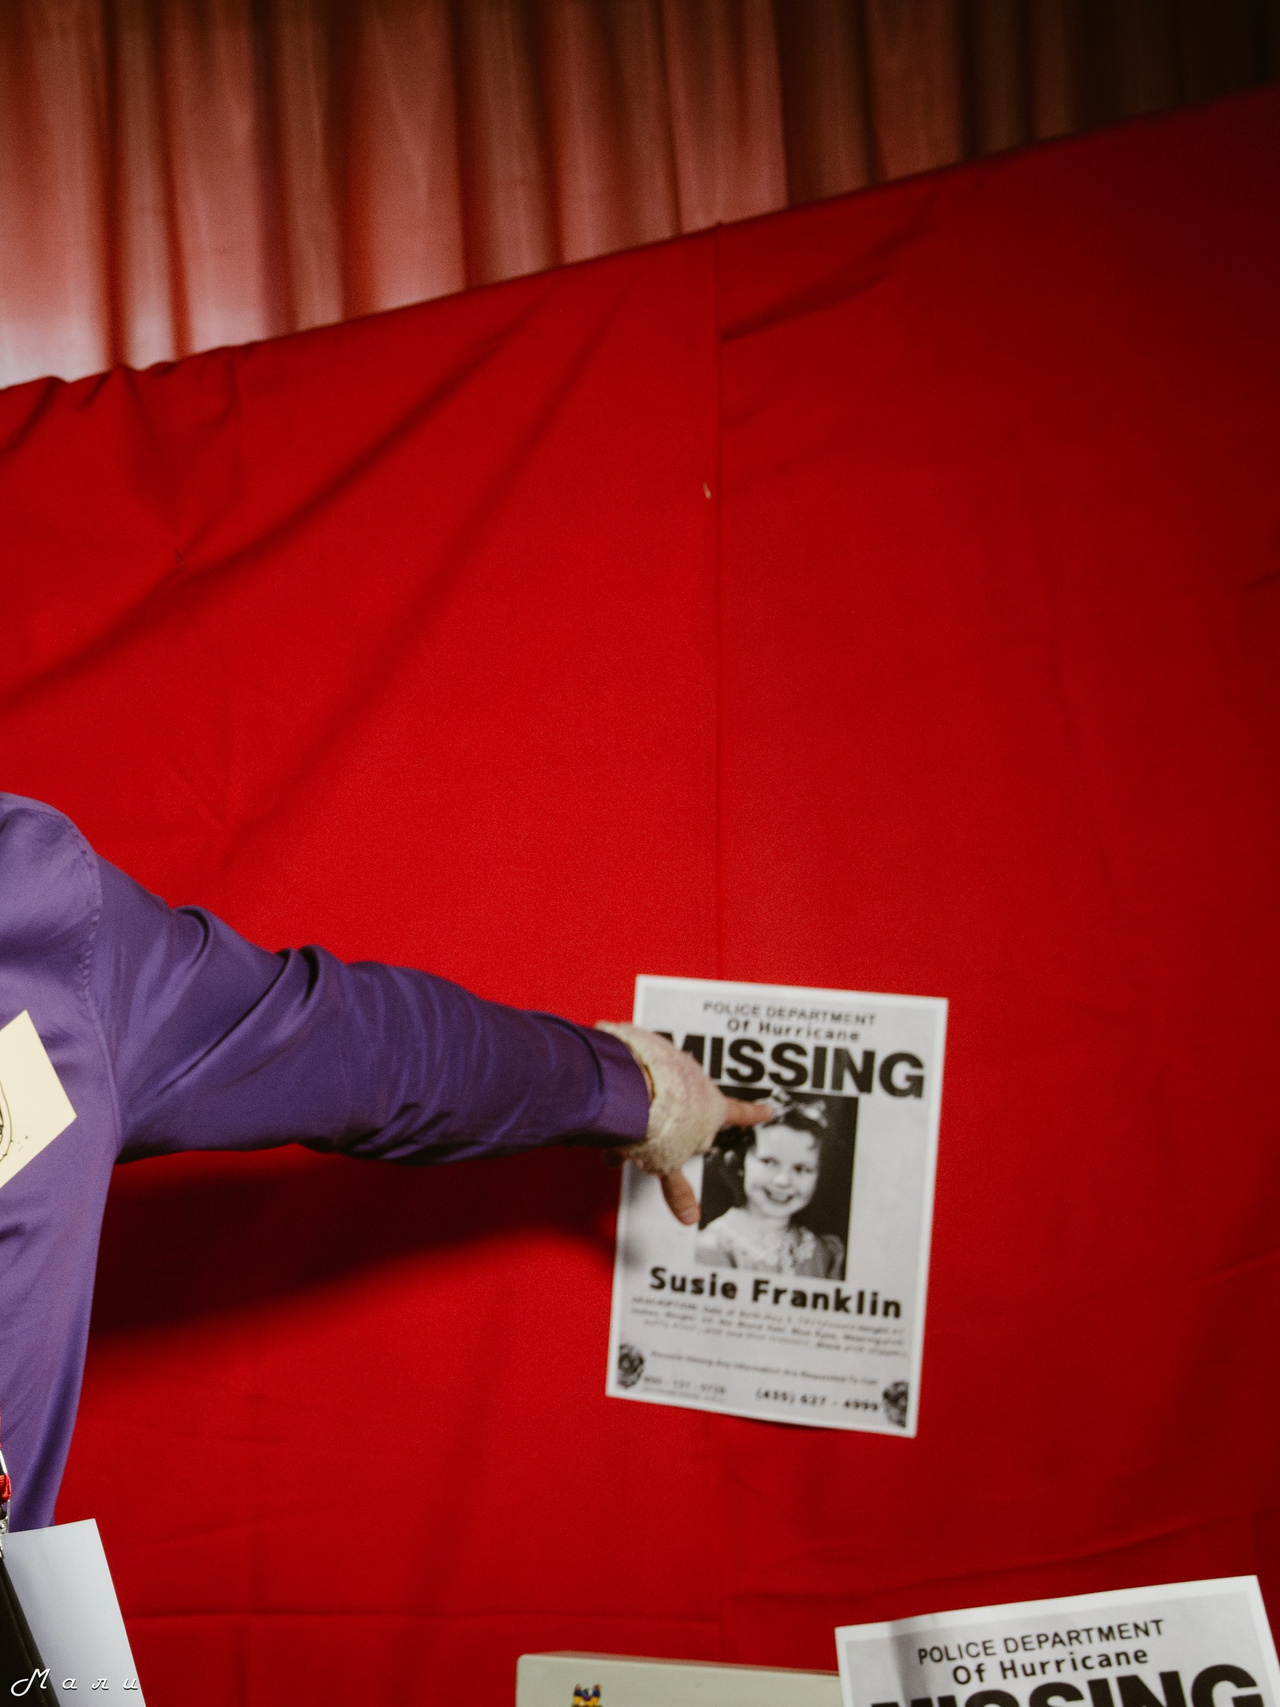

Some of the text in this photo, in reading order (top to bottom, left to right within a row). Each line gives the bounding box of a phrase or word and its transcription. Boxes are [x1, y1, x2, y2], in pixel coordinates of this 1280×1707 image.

[703, 1001, 876, 1025] POLICE DEPARTMENT
[727, 1018, 860, 1041] Of Hurricane
[650, 1266, 902, 1319] Susie Franklin
[918, 1619, 1164, 1665] POLICE DEPARTMENT
[952, 1649, 1148, 1685] Of Hurricane
